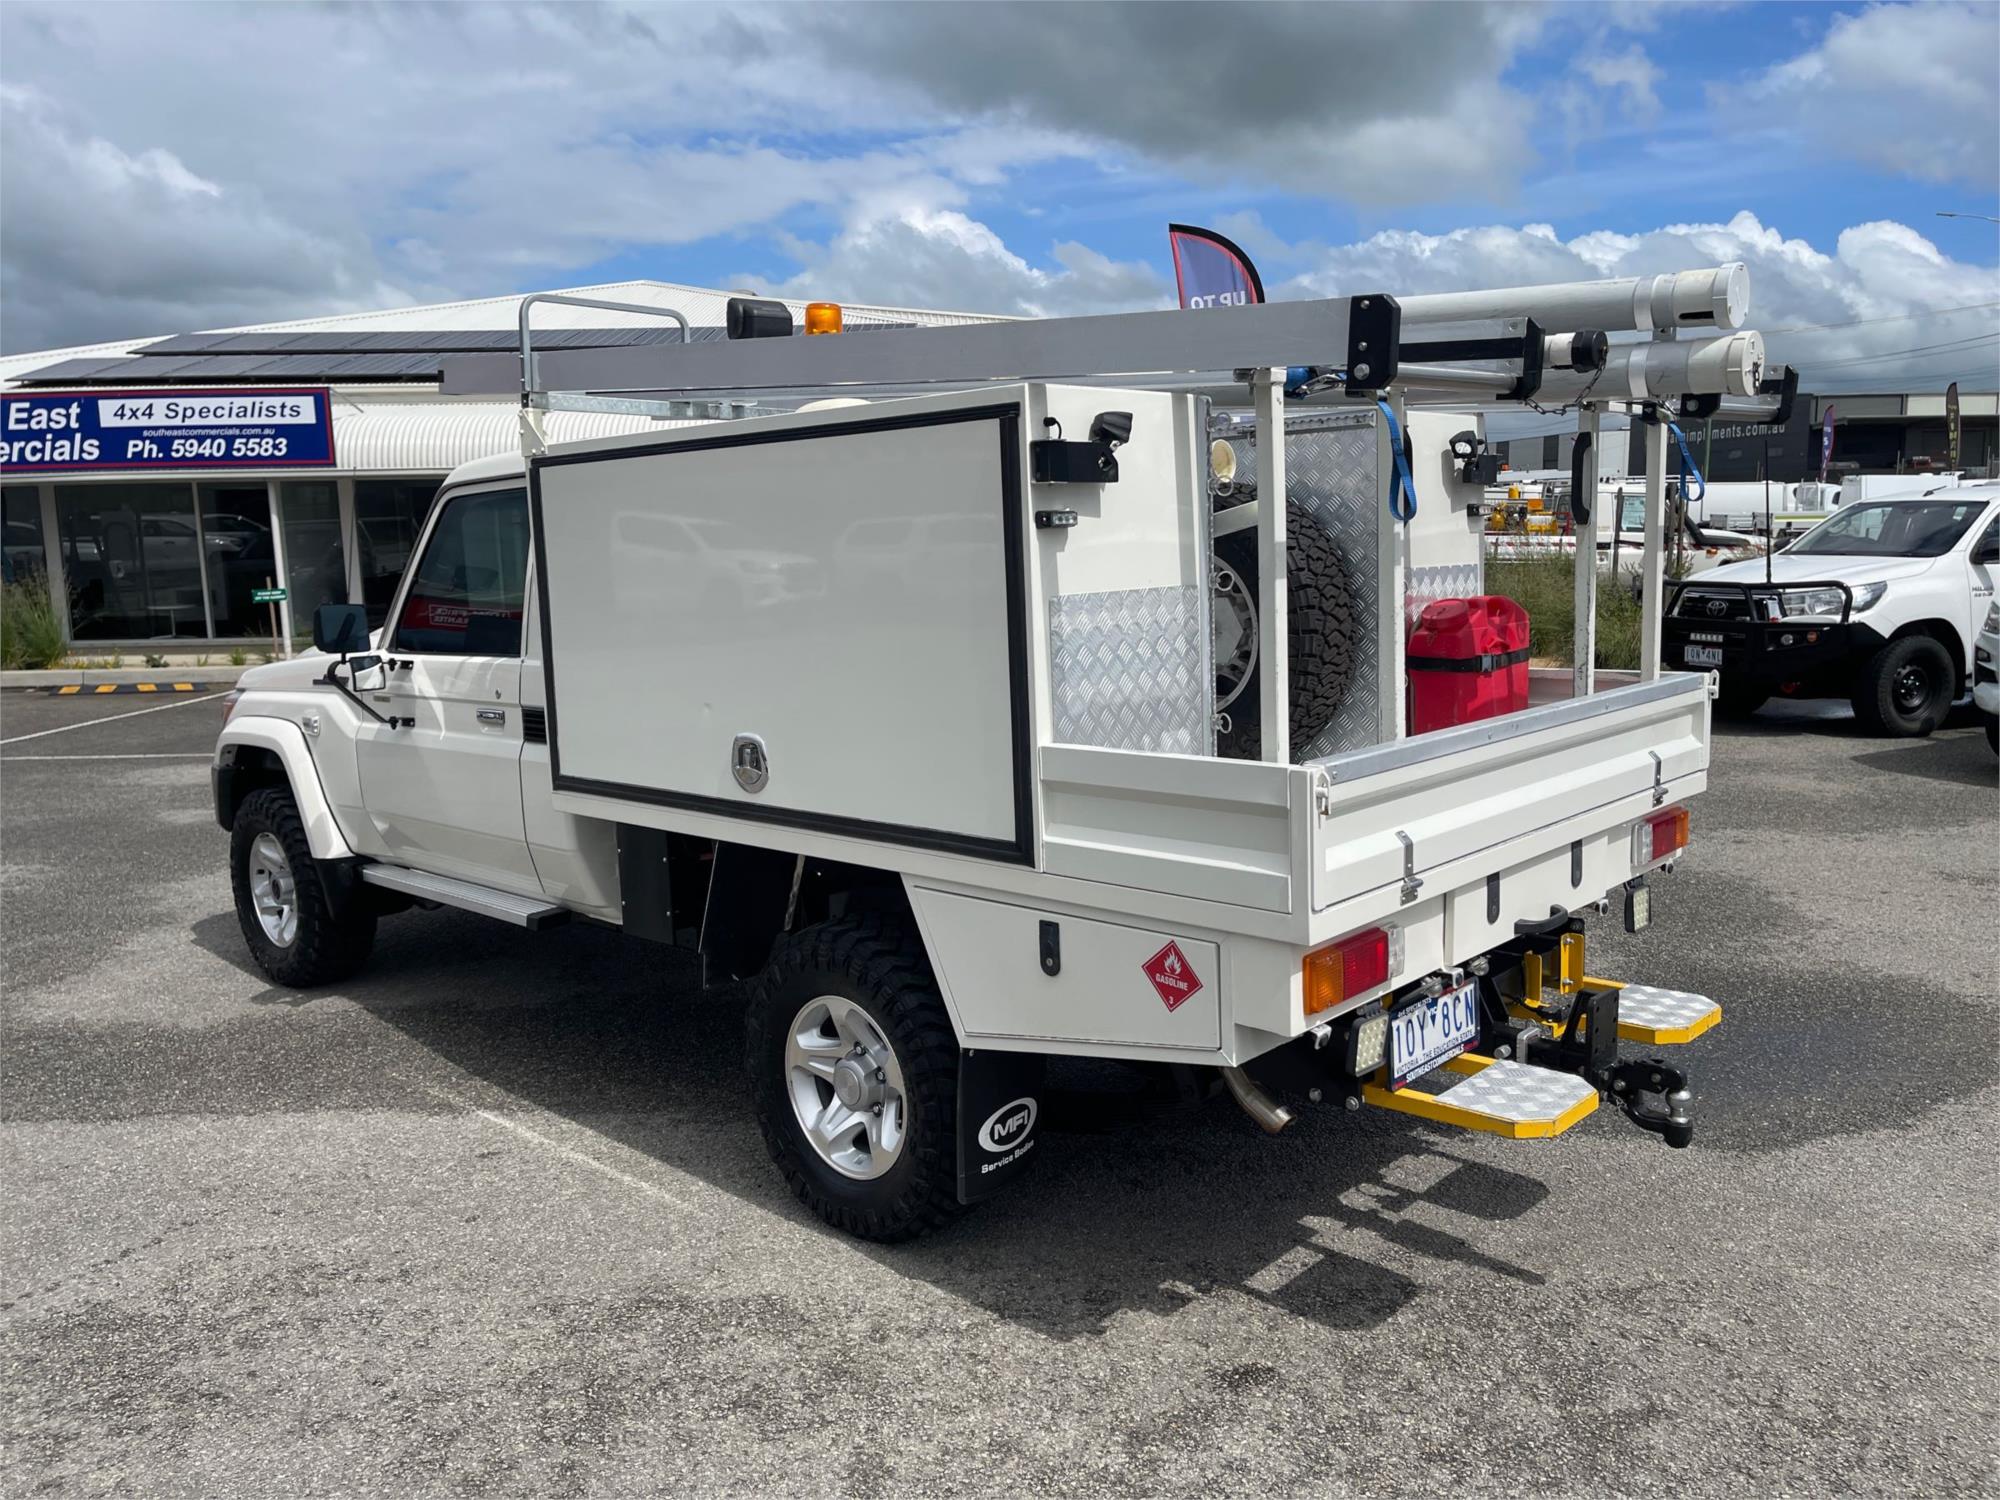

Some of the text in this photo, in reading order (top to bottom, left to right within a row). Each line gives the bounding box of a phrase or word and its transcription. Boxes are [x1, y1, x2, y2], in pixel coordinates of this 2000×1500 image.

[8, 402, 81, 430] East
[113, 401, 301, 423] 4x4 Specialists
[142, 427, 276, 438] southeastcommercials.com.au
[126, 437, 288, 459] Ph. 5940 5583
[1155, 972, 1189, 991] GASOLINE
[1168, 995, 1174, 1005] 3
[1396, 1057, 1419, 1075] VICTORIA
[1423, 1049, 1433, 1060] THE
[1433, 1037, 1459, 1056] EDUCATION
[1459, 1028, 1474, 1042] STATE
[994, 1109, 1028, 1141] MFI
[981, 1154, 1014, 1174] Service
